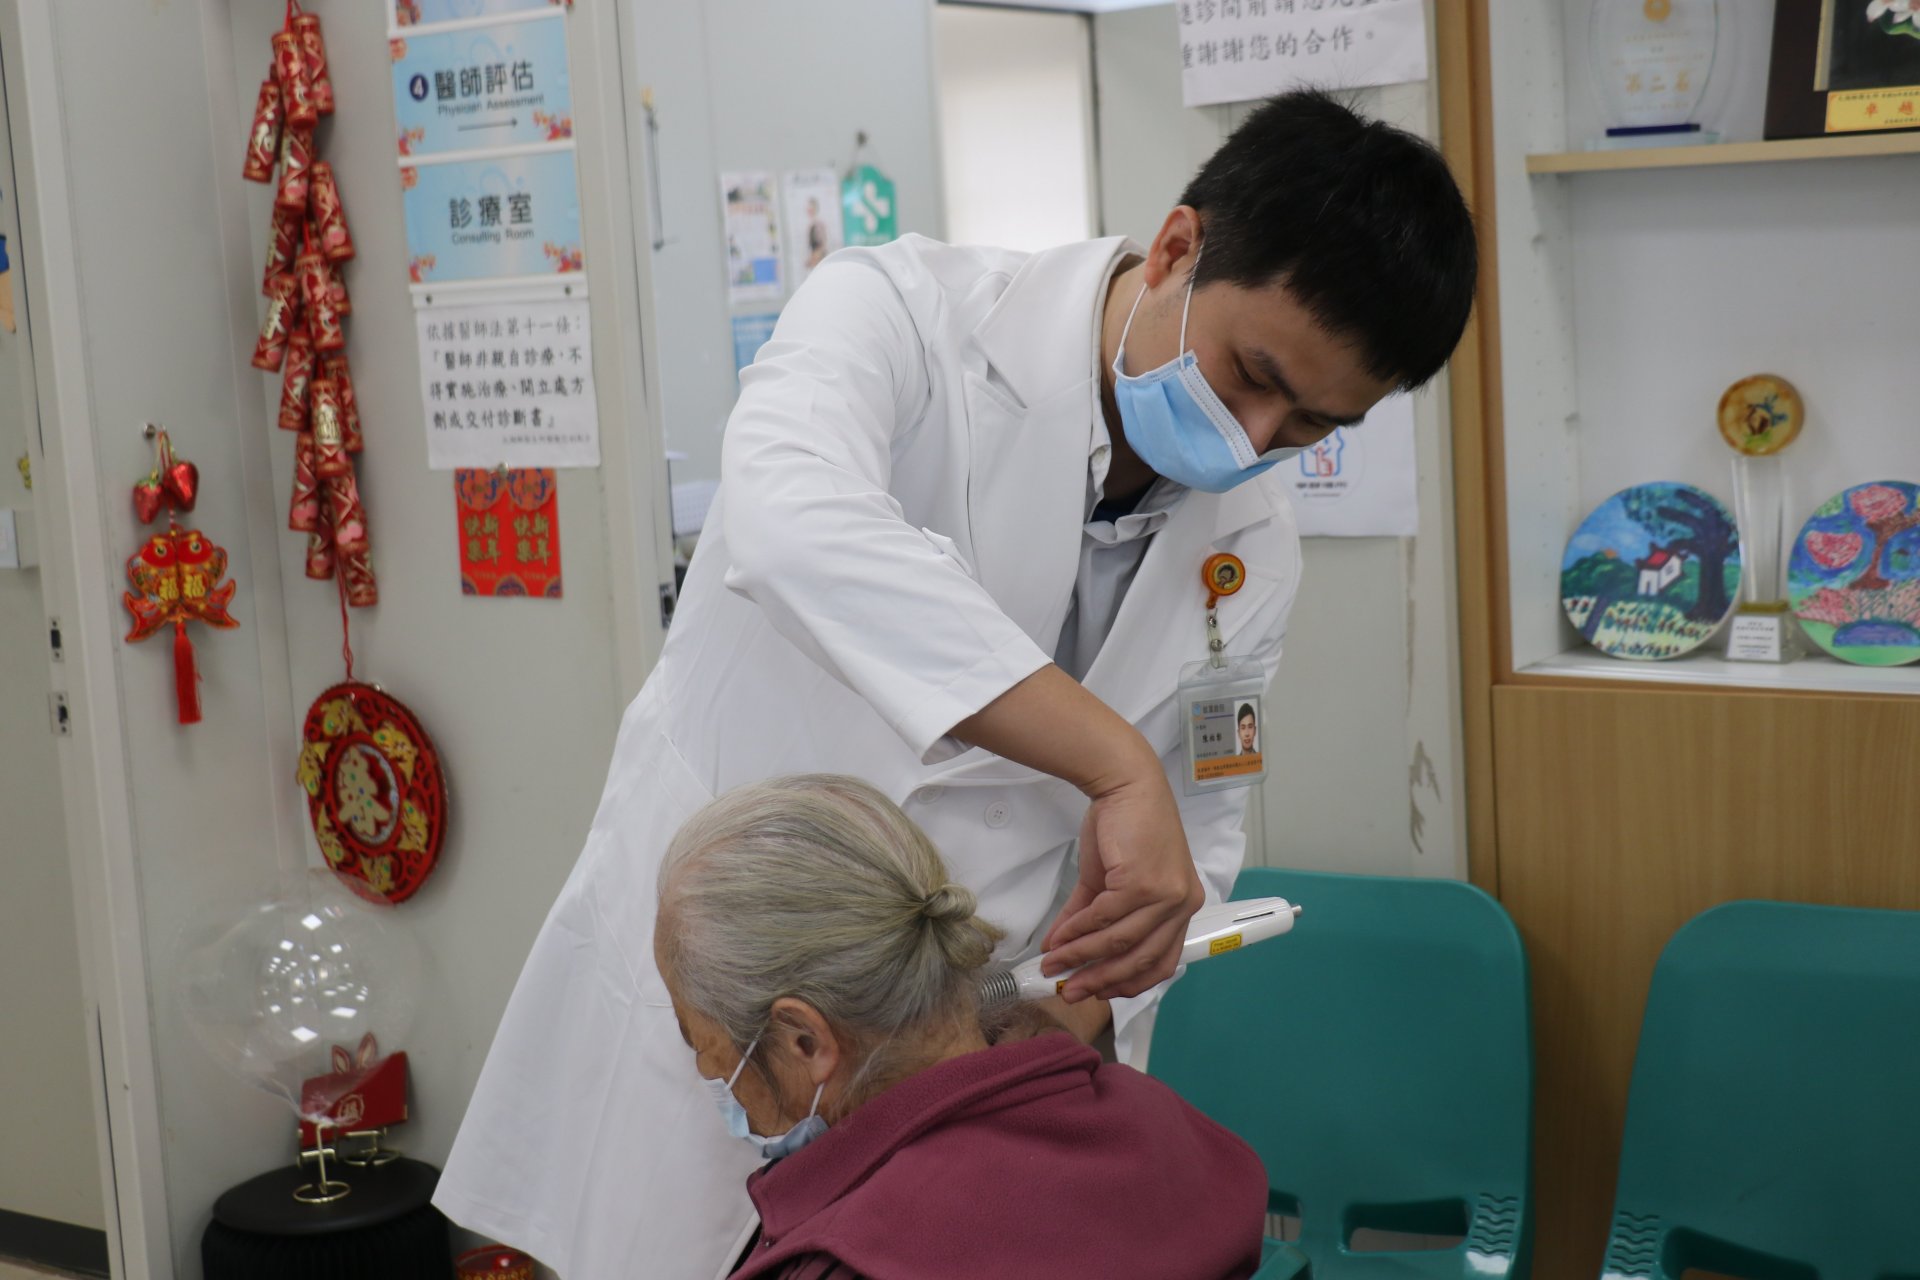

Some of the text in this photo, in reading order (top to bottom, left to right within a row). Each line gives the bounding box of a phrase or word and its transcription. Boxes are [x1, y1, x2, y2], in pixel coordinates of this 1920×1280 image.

[434, 60, 534, 101] 醫師評估
[438, 94, 544, 116] Physician Assessment
[449, 192, 532, 229] 診療室
[452, 229, 534, 245] Consulting Room
